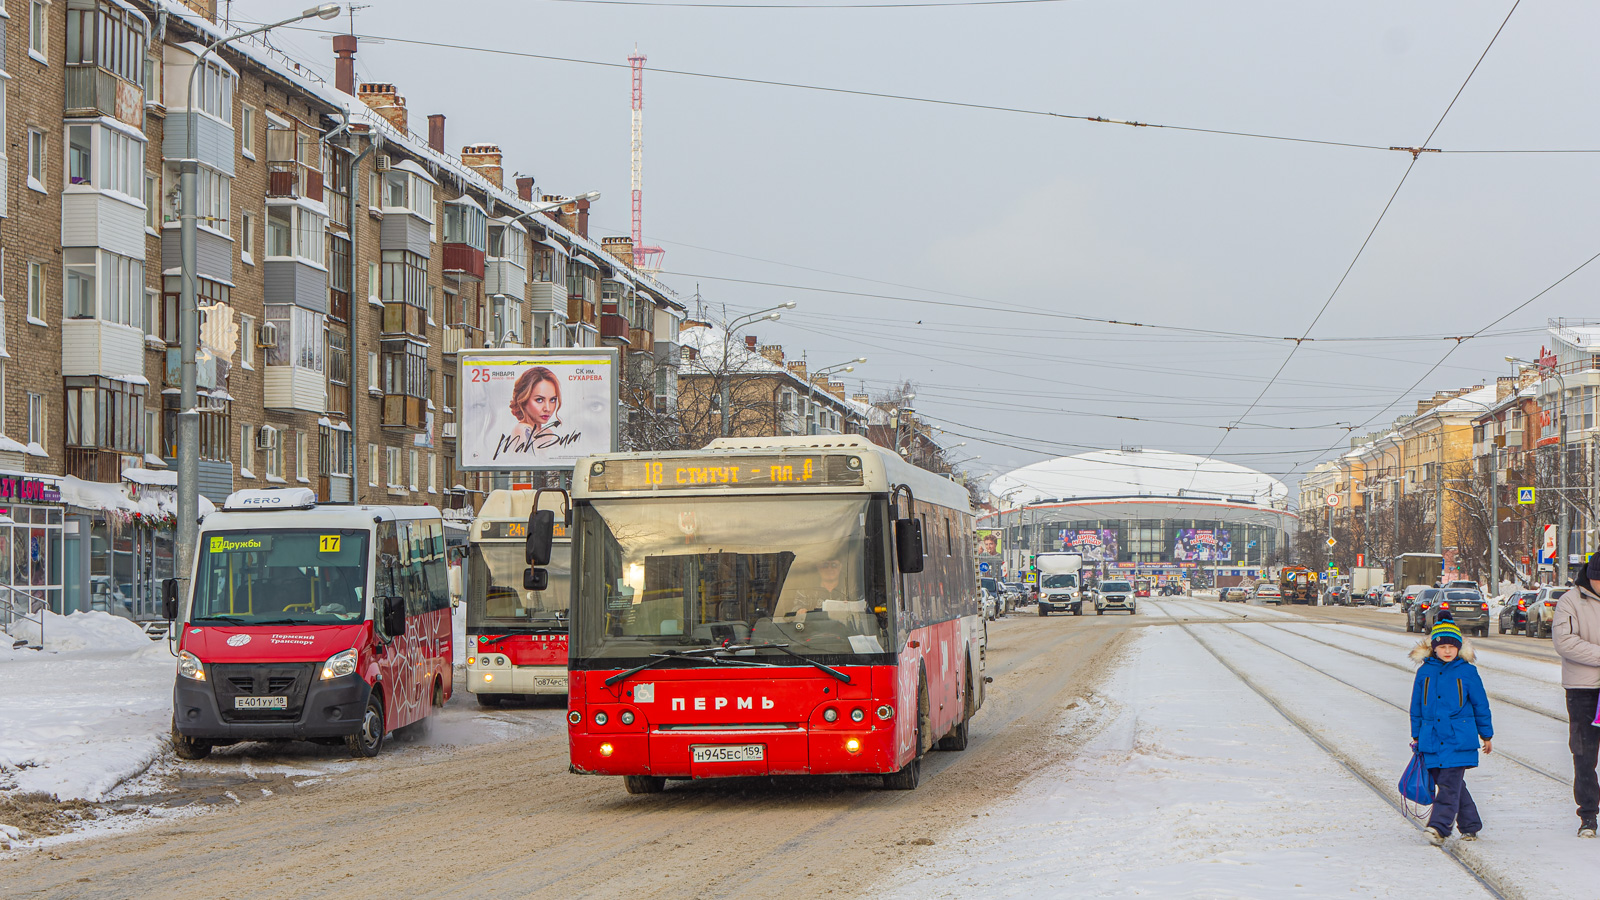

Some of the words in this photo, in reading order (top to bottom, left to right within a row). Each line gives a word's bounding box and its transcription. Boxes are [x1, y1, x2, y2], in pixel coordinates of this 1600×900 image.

[471, 368, 491, 382] 25
[645, 462, 663, 484] 18
[21, 479, 45, 500] LOVE
[211, 541, 222, 549] 17
[223, 538, 261, 550] Дружбы
[321, 537, 340, 550] 17
[672, 696, 775, 711] ПЕРМЬ
[743, 746, 760, 756] 159
